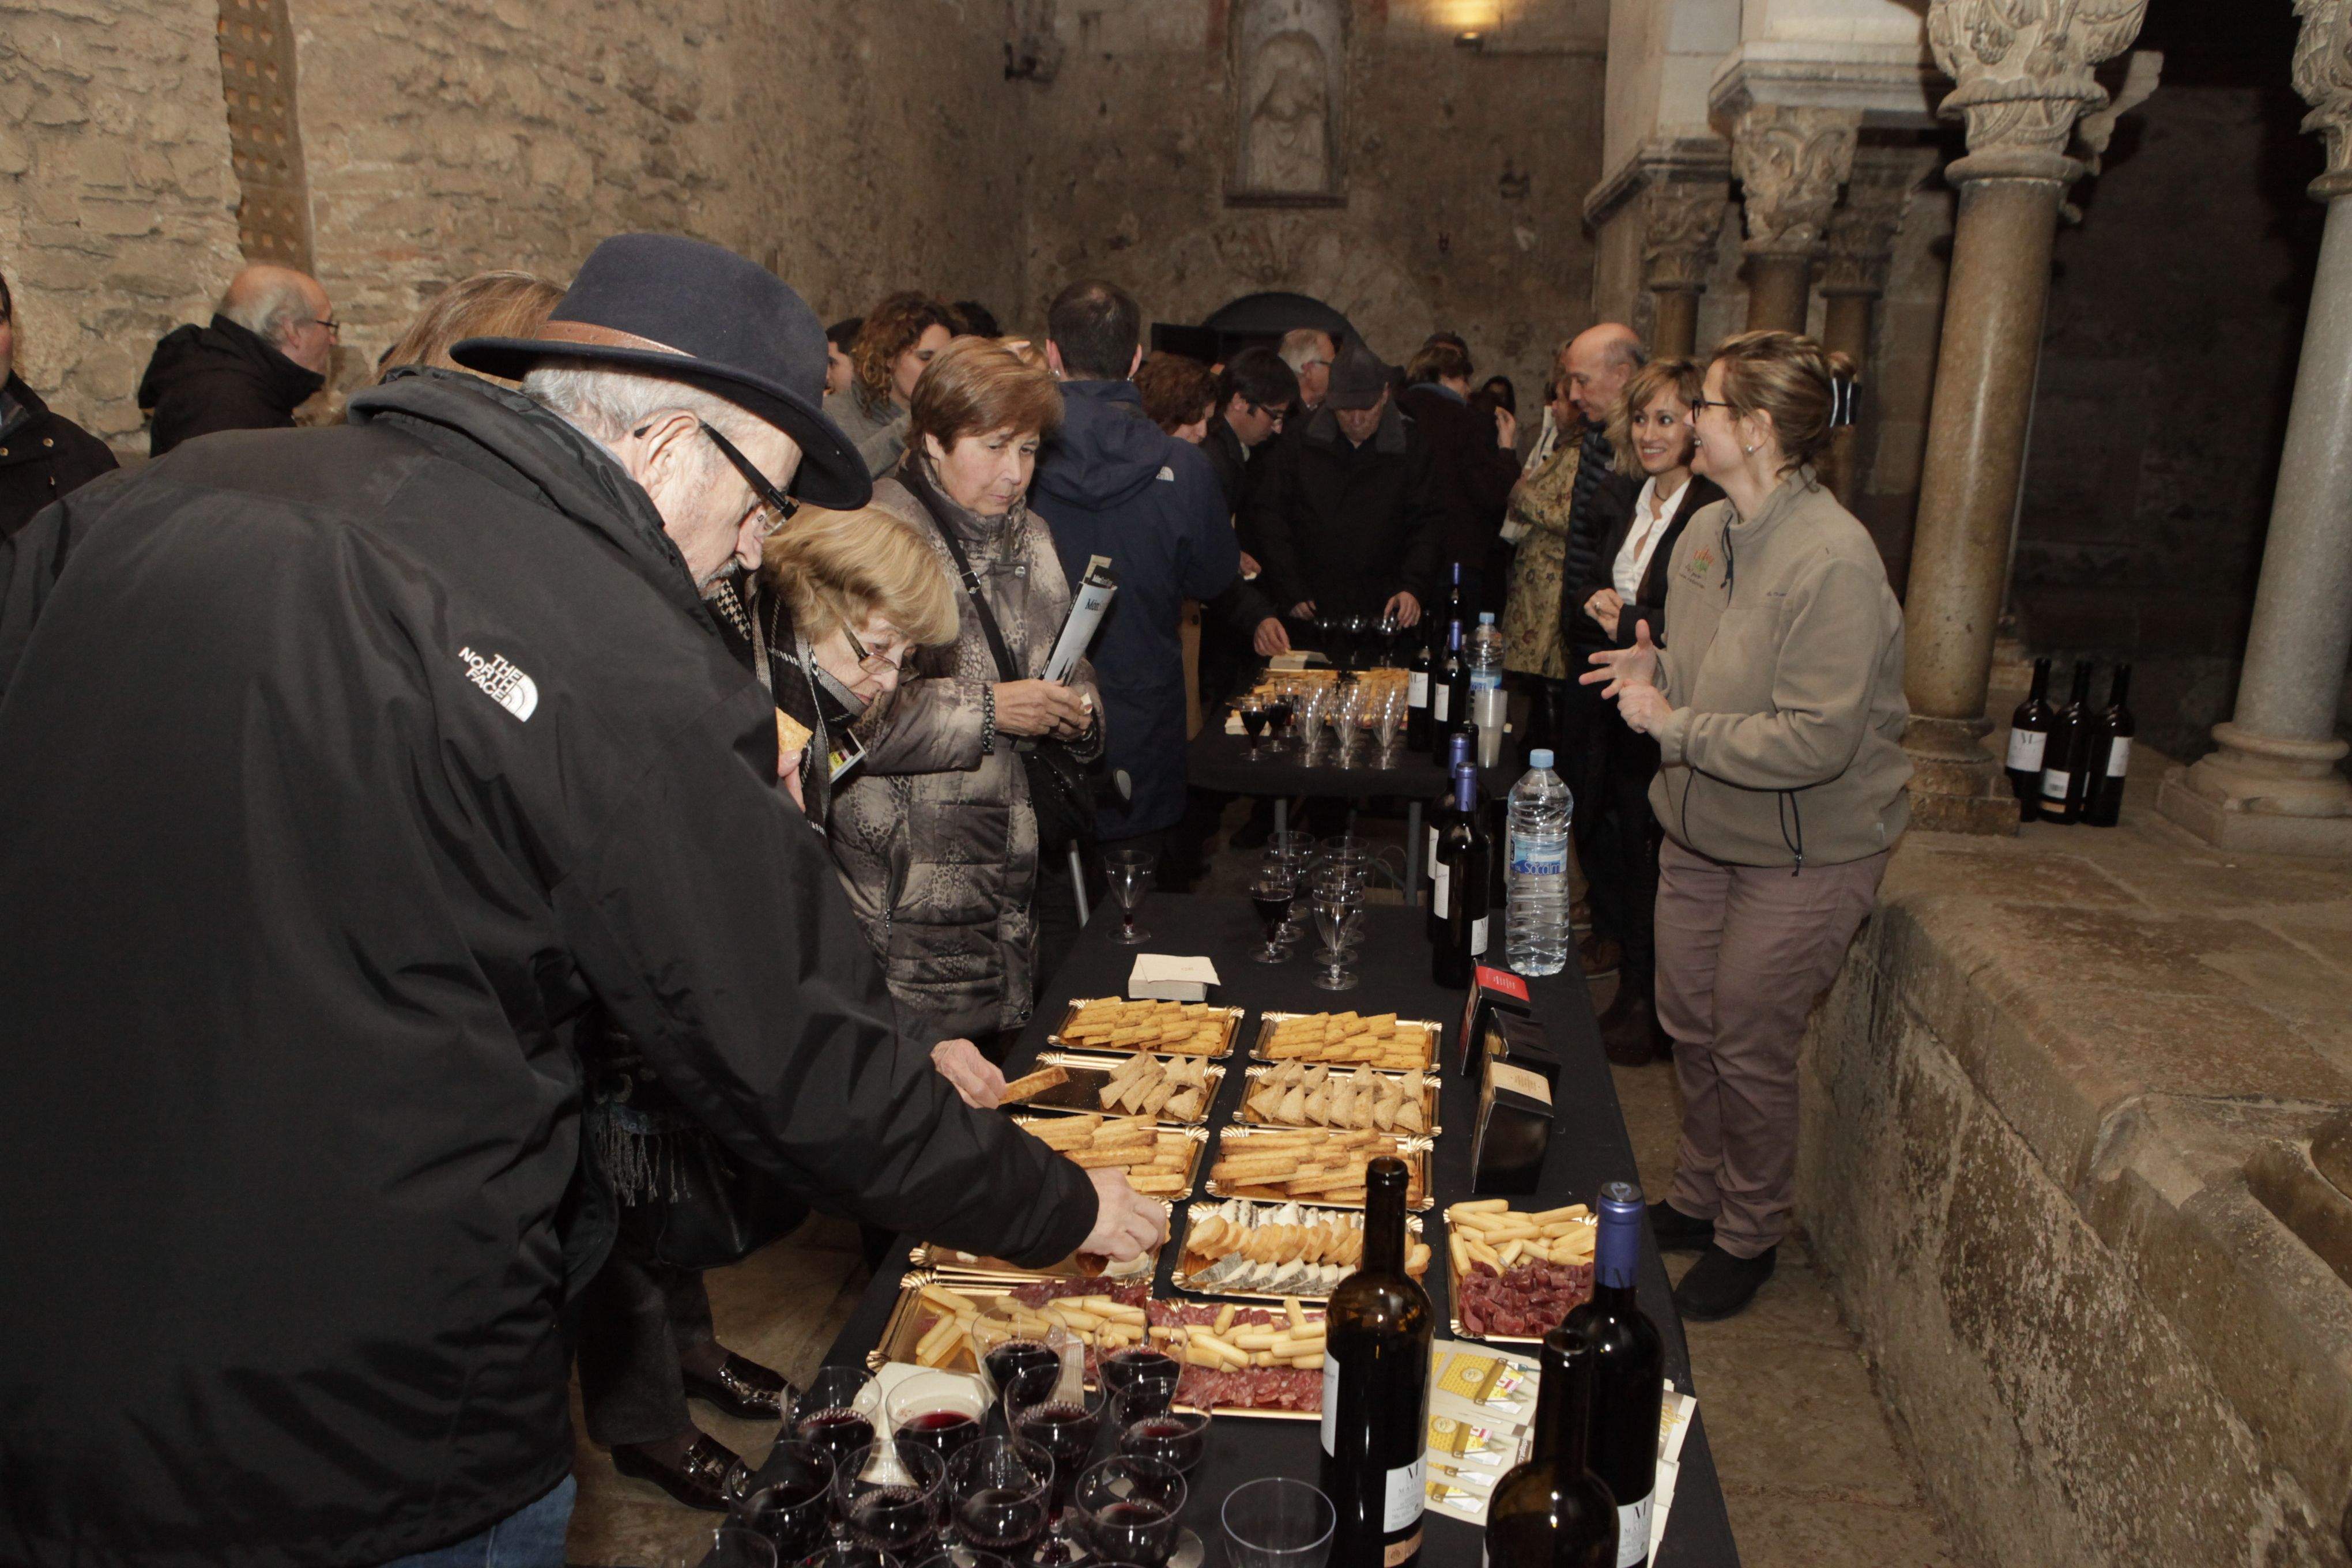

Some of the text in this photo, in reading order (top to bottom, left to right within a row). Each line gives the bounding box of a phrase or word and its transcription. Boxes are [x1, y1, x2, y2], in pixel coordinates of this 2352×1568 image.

[458, 646, 515, 693] NORTH
[492, 653, 525, 683] THE
[465, 668, 507, 702] FACE
[1524, 862, 1561, 875] Sacalm
